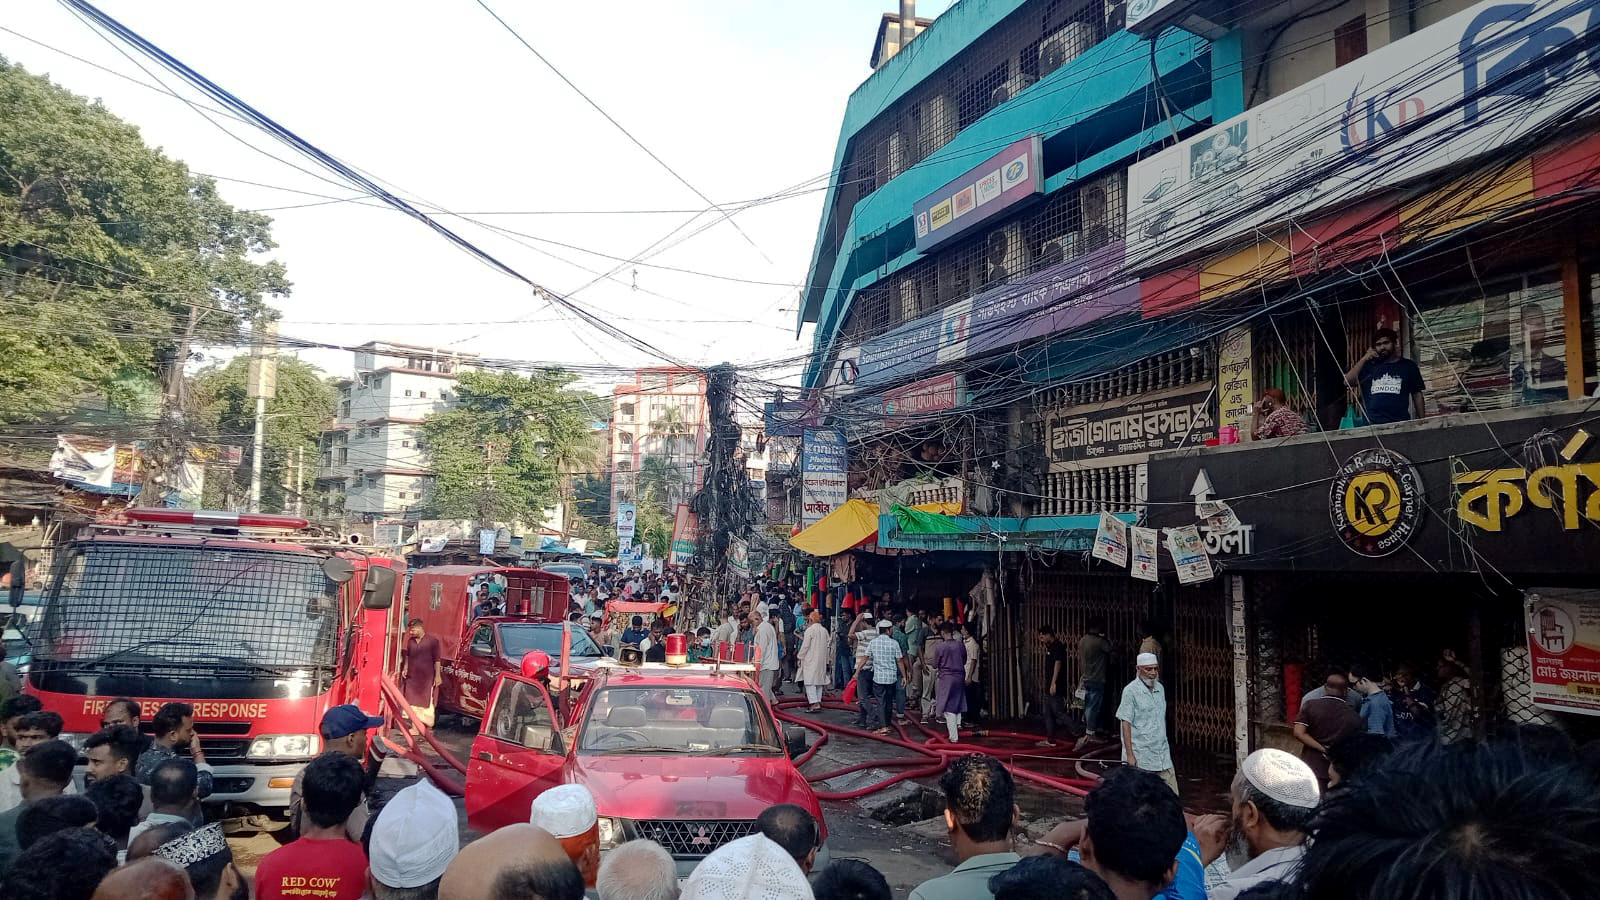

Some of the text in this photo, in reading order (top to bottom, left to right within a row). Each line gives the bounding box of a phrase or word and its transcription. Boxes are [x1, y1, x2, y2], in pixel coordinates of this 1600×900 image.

[1459, 4, 1600, 125] কি
[1354, 453, 1391, 469] Rine
[1401, 473, 1415, 519] Carpet
[1377, 521, 1411, 549] House
[1536, 666, 1557, 679] মোঃ
[82, 700, 113, 715] FIR
[192, 702, 268, 718] RESPONSE
[281, 876, 336, 888] RED COW
